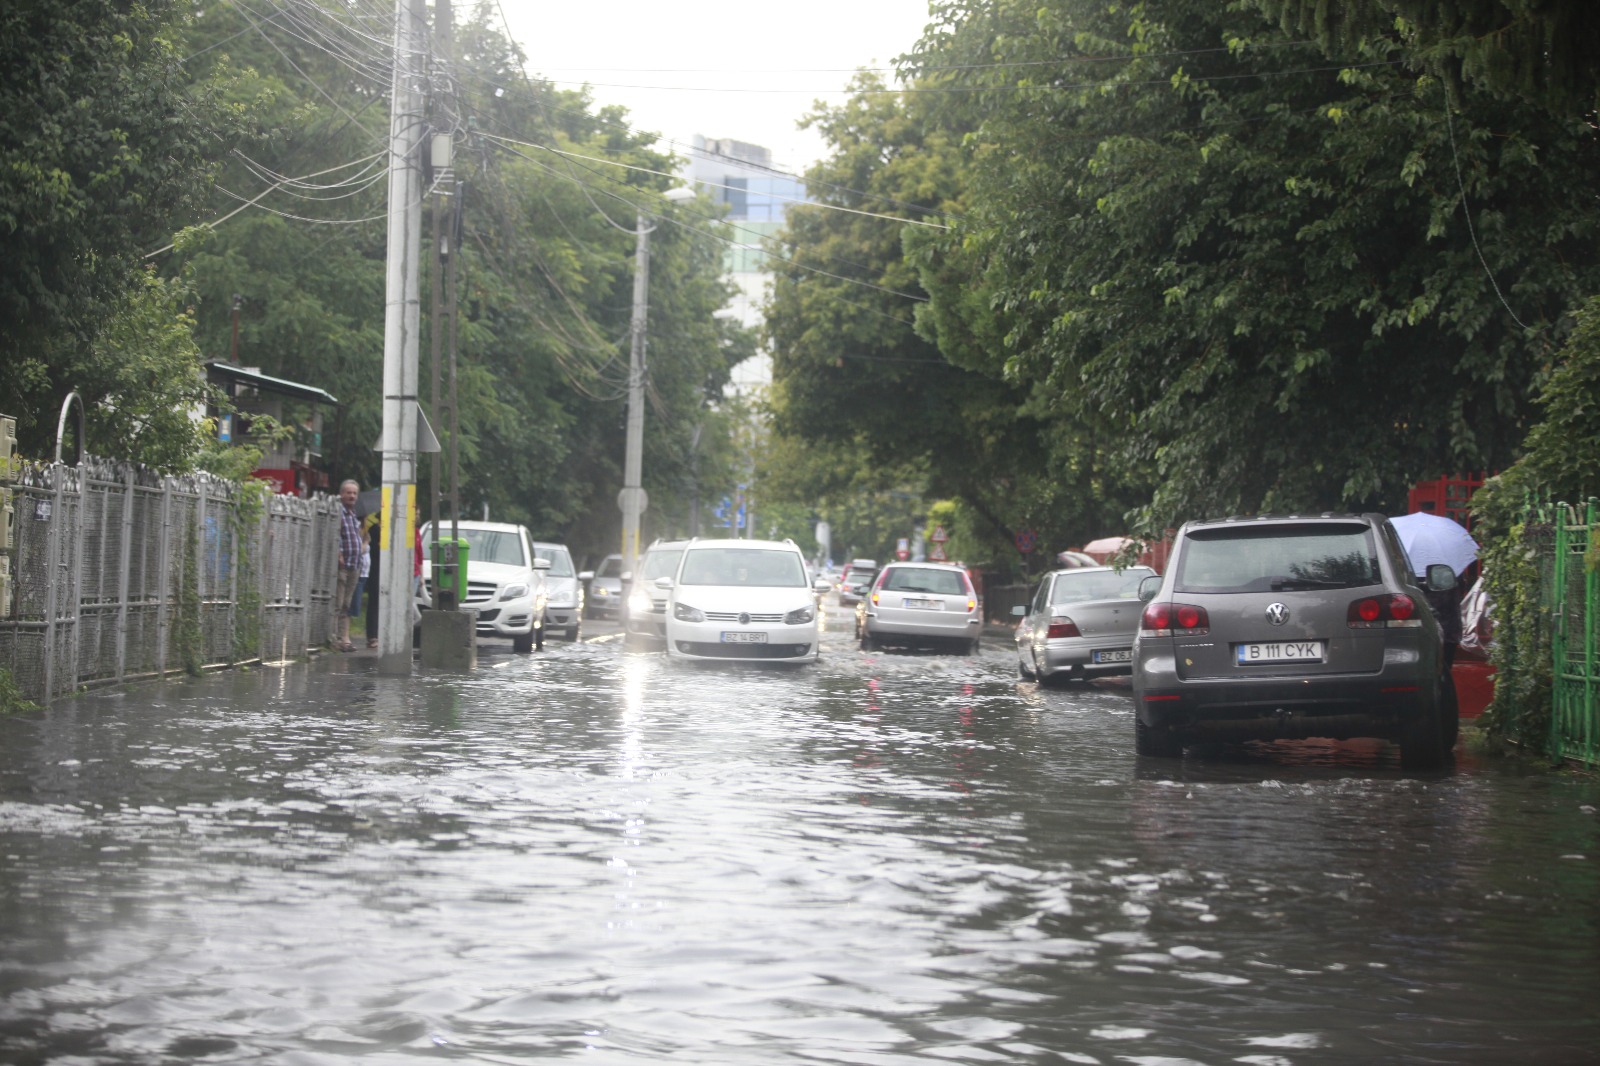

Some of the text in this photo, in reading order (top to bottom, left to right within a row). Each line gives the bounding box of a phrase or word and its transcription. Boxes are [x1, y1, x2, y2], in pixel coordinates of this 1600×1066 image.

[726, 633, 738, 642] BZ
[1250, 643, 1316, 659] B 111 CYK
[1101, 652, 1113, 662] BZ
